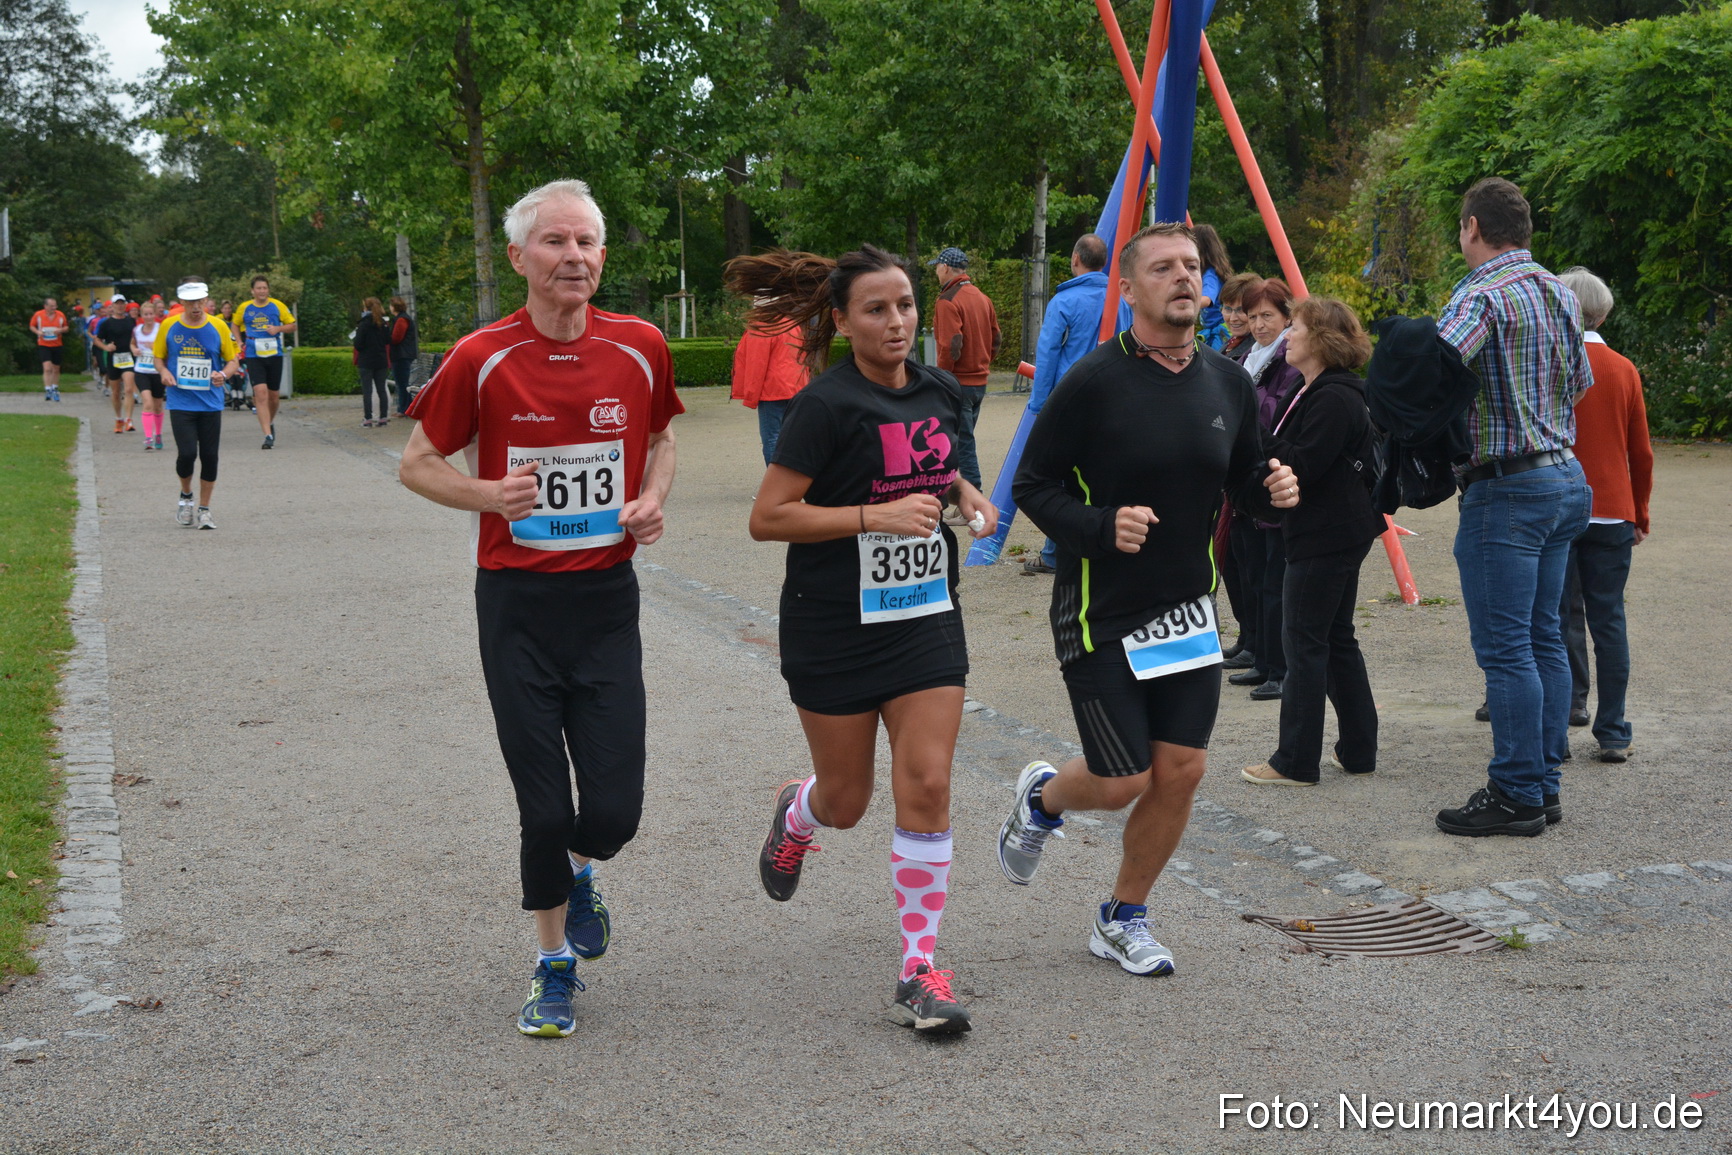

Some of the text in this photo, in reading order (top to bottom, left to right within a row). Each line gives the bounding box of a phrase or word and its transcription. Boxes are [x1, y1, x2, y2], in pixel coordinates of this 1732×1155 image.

[180, 365, 208, 379] 2410
[1211, 422, 1226, 431] adidas
[552, 453, 605, 465] Neumarkt
[872, 468, 958, 493] Kosmetikstudi
[550, 519, 589, 536] Horst
[861, 533, 895, 543] PARTL
[871, 540, 942, 583] 3392
[880, 585, 928, 610] Kerstin
